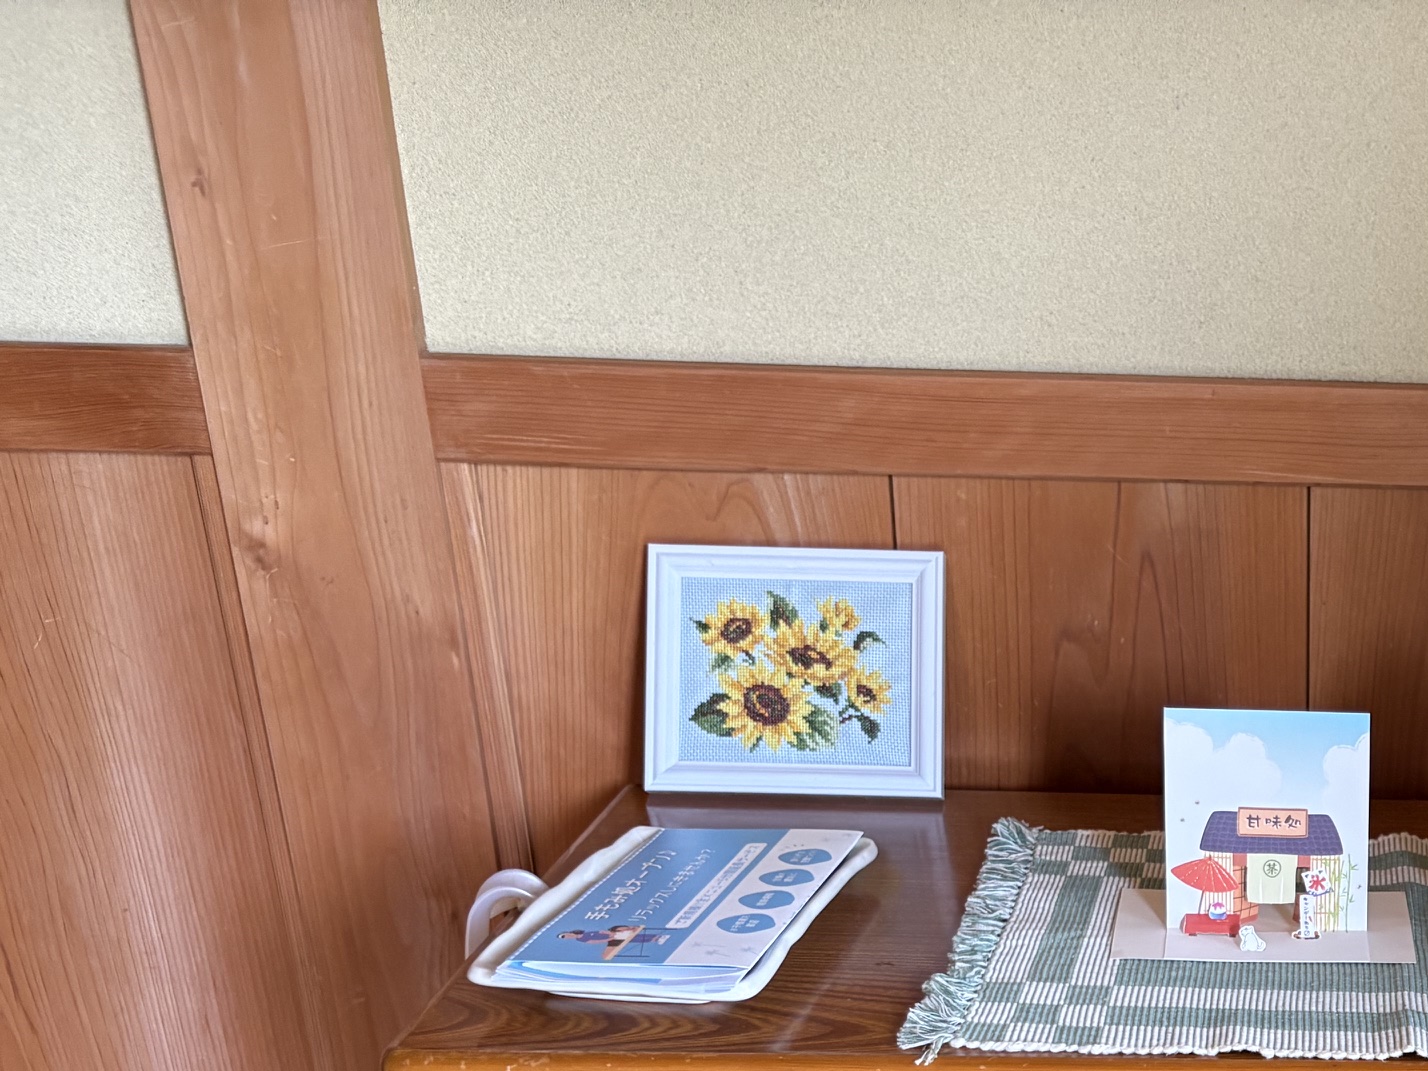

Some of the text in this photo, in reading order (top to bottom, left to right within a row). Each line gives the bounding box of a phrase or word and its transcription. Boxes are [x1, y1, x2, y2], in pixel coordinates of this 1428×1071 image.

[1246, 814, 1302, 829] 甘味処
[1265, 861, 1280, 877] 茶
[1308, 874, 1327, 891] 氷
